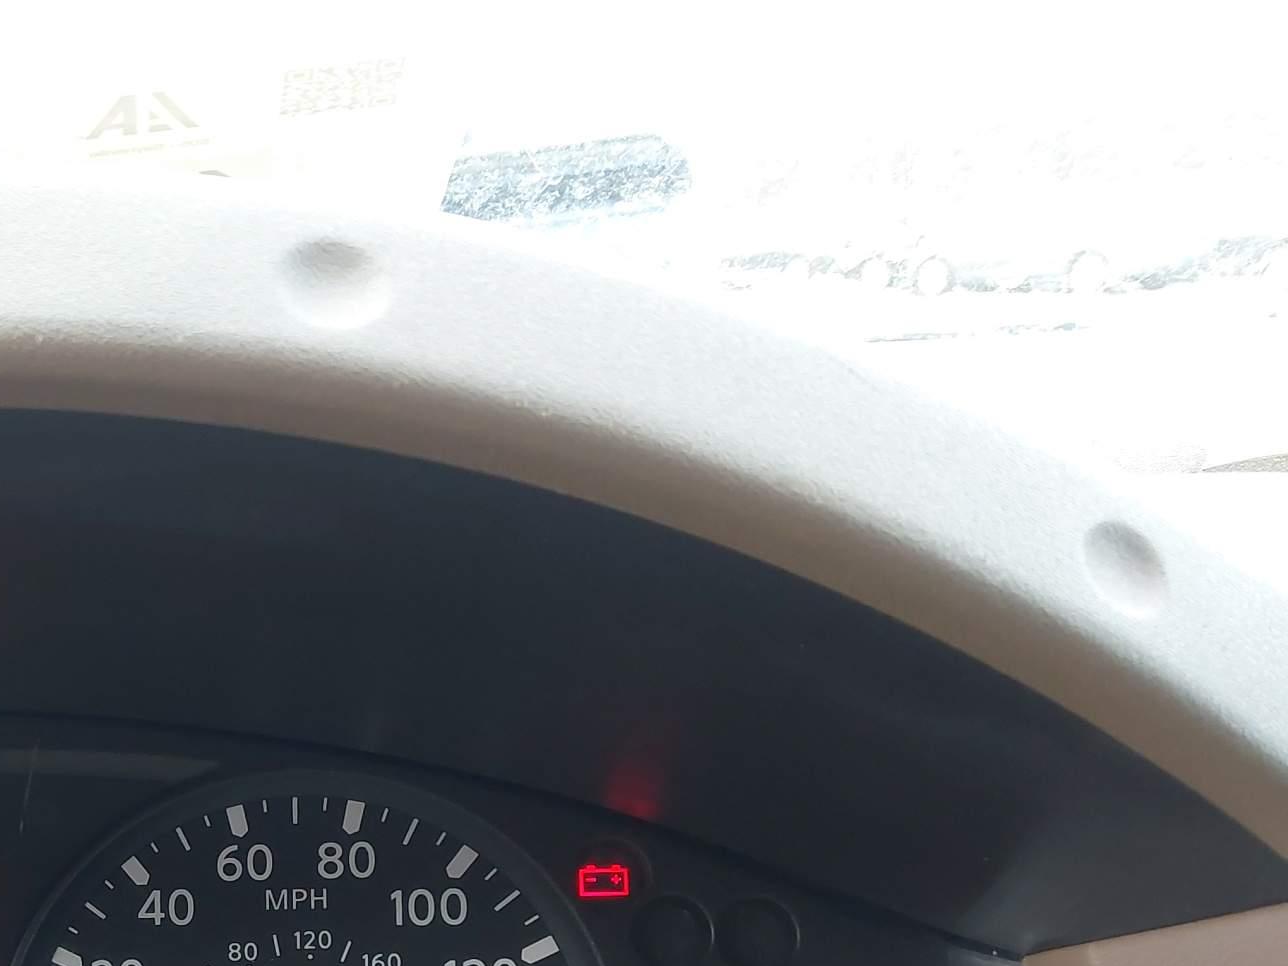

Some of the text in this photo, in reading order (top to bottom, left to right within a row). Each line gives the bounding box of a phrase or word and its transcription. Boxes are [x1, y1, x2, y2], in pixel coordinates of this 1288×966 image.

[218, 845, 272, 881] 60
[318, 842, 375, 878] 80
[138, 889, 193, 925] 40
[265, 889, 327, 910] MPH
[391, 888, 467, 925] 100
[228, 943, 258, 961] 80
[294, 931, 332, 950] 120
